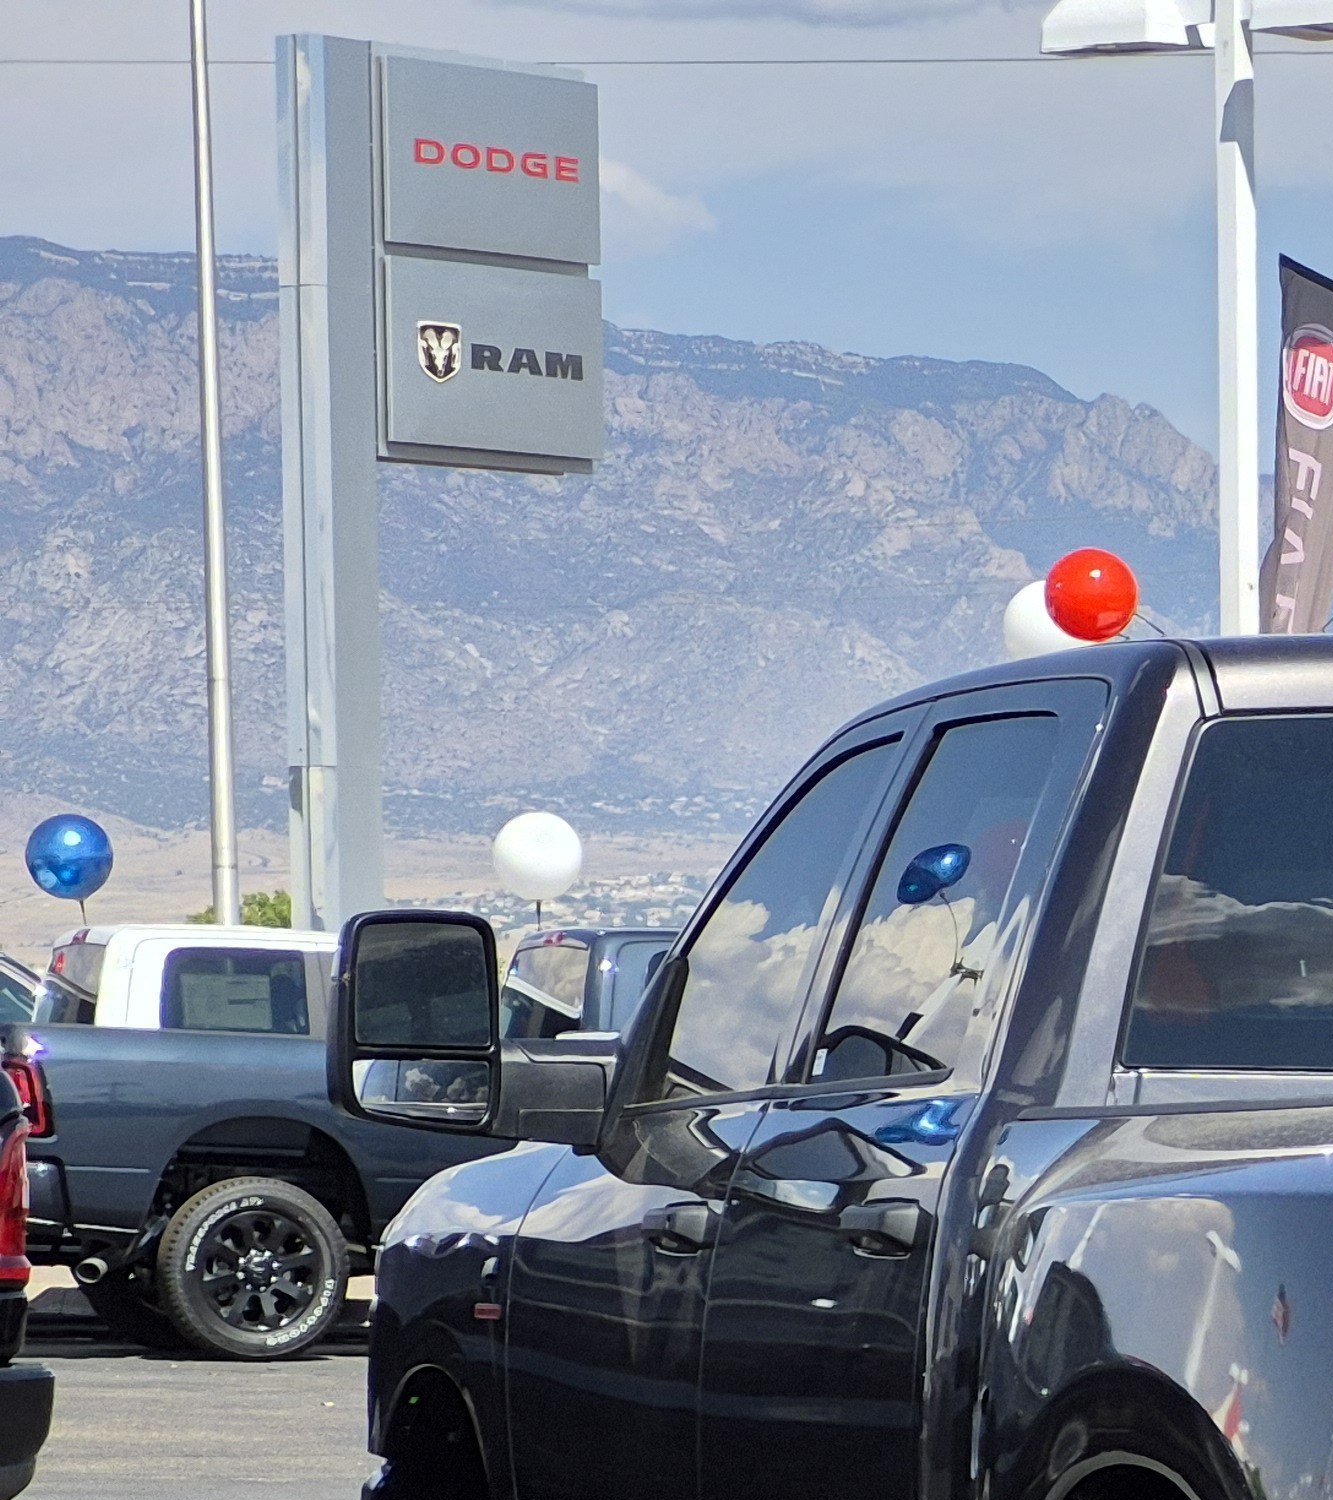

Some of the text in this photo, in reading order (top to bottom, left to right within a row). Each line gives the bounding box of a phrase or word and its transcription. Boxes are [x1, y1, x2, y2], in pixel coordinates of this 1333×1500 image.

[413, 137, 580, 183] DODGE
[470, 342, 584, 382] RAM
[1275, 446, 1323, 634] FIAT
